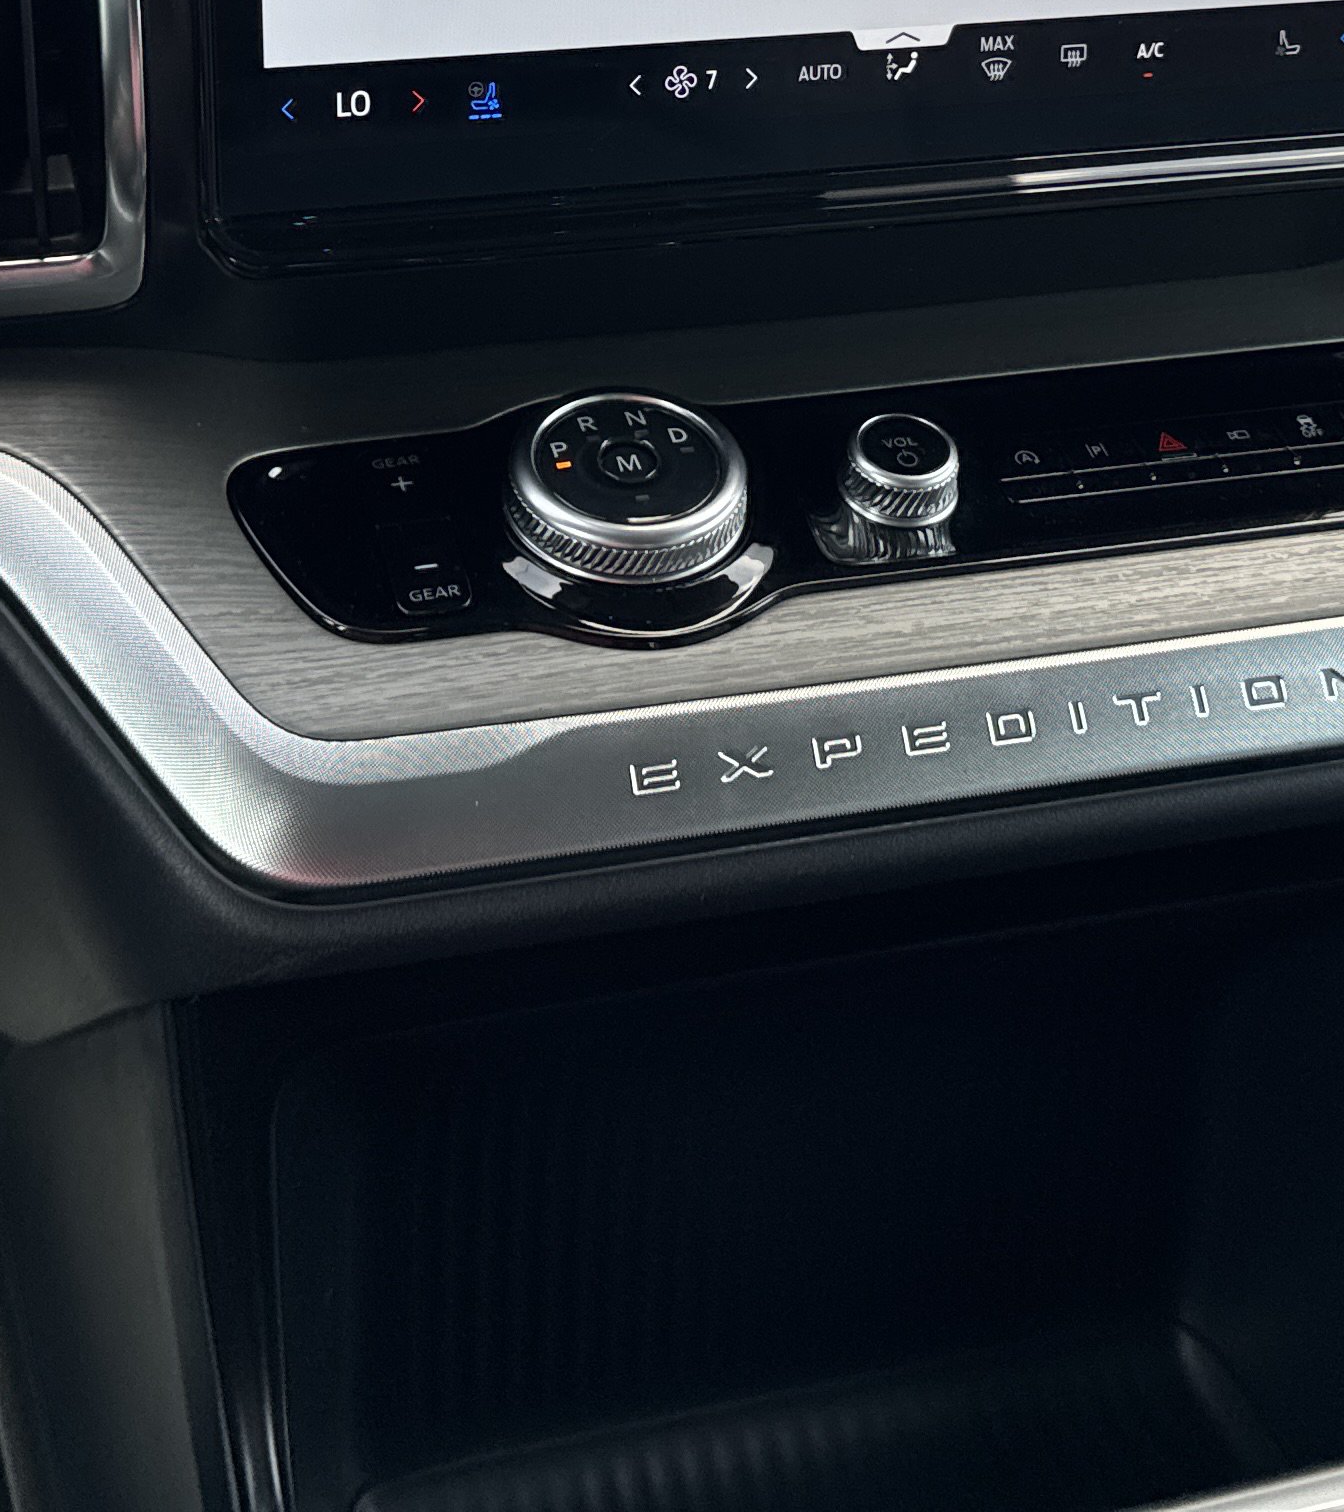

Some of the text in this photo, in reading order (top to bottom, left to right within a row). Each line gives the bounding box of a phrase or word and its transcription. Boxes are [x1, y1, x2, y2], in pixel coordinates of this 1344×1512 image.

[979, 34, 1015, 52] MAX
[1136, 41, 1165, 61] A/C
[705, 69, 718, 90] 7
[798, 64, 842, 83] AUTO
[335, 91, 371, 119] LO
[551, 409, 688, 459] P R N D
[882, 436, 919, 450] VOL
[371, 452, 420, 470] GEAR
[616, 453, 643, 473] M
[408, 583, 462, 603] GEAR
